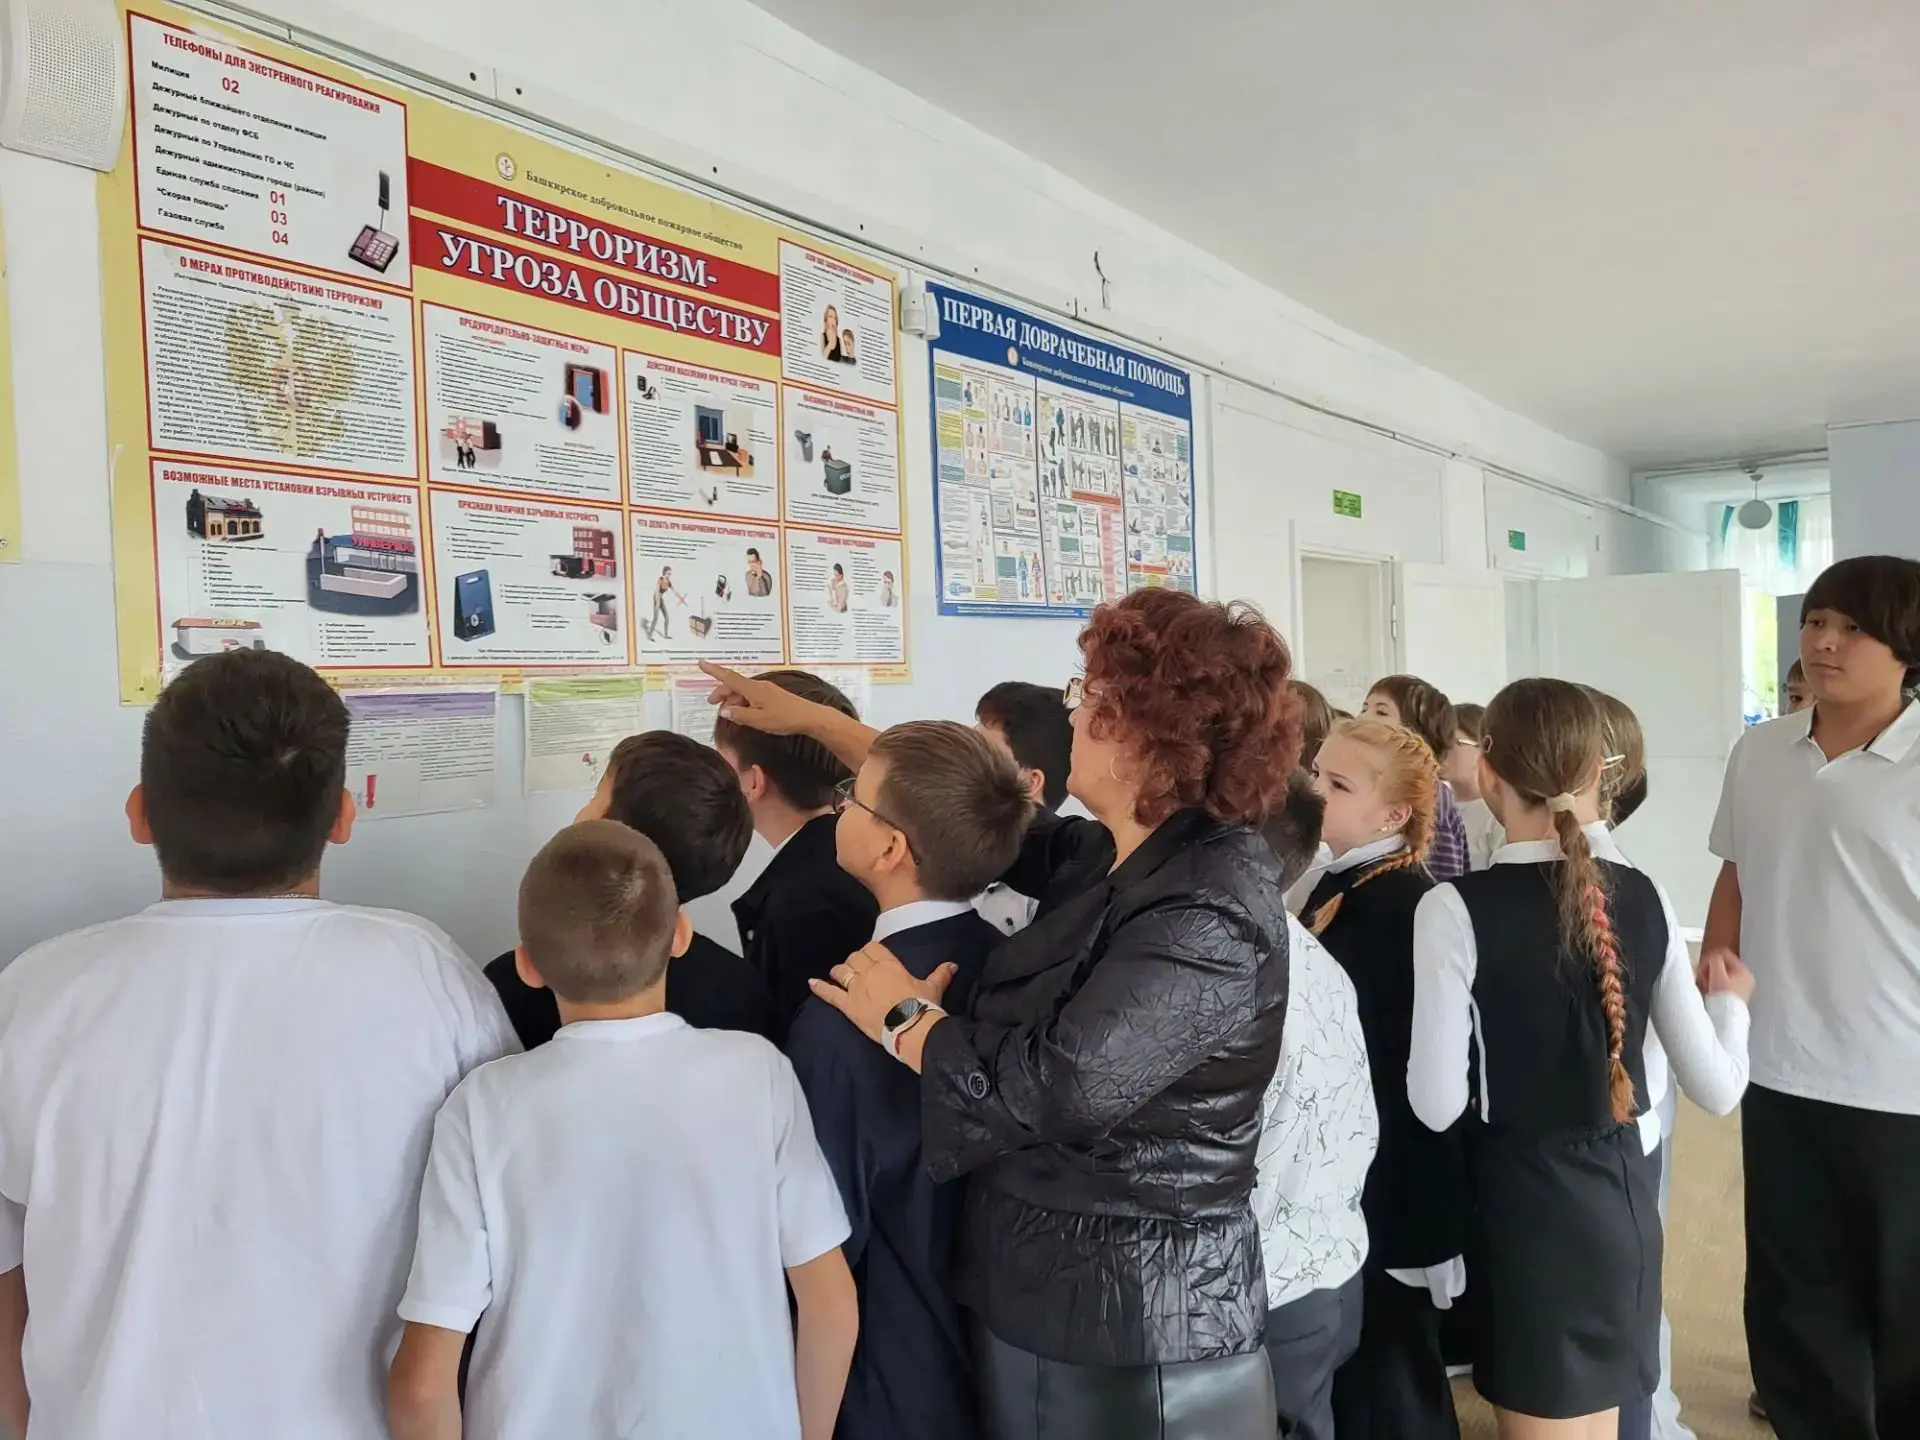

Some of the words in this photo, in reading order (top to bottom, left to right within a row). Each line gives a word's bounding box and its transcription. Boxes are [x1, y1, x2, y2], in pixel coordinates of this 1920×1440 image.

[151, 60, 190, 79] Милиция
[163, 33, 223, 62] ТЕЛЕФОНЫ
[224, 53, 246, 69] ДЛЯ
[248, 60, 313, 92] ЭКСТРЕННОГО
[315, 81, 381, 113] РЕАГИРОВАНИЯ
[222, 77, 240, 95] 02
[152, 82, 198, 102] Дежурный
[200, 95, 251, 118] ближайшего
[252, 113, 293, 131] отделения
[153, 103, 198, 123] Дежурный
[200, 117, 211, 126] по
[212, 120, 240, 136] отделу
[242, 128, 259, 140] ФСБ
[154, 124, 199, 144] Дежурный
[201, 137, 211, 146] по
[213, 140, 263, 161] Управлению
[264, 154, 275, 164] ГО
[283, 159, 295, 170] ЧС
[155, 145, 200, 165] Дежурный
[202, 158, 264, 181] администрации
[266, 175, 292, 189] города
[294, 182, 326, 199] (района)
[156, 166, 187, 181] Единая
[189, 174, 220, 190] служба
[222, 184, 260, 200] спасения
[270, 191, 286, 206] 01
[271, 211, 287, 226] 03
[526, 170, 588, 202] Башкирское
[589, 196, 656, 225] добровольное
[657, 215, 702, 239] пожарное
[703, 231, 743, 250] общество
[158, 208, 192, 224] Газовая
[194, 215, 225, 232] служба
[272, 231, 289, 246] 04
[497, 194, 718, 288] ТЕРРОРИЗМ-
[180, 255, 188, 268] О
[190, 258, 223, 276] МЕРАХ
[225, 266, 324, 297] ПРОТИВОДЕЙСТВИЮ
[326, 289, 383, 310] ТЕРРОРИЗМУ
[437, 231, 589, 304] УГРОЗА
[593, 277, 771, 347] ОБЩЕСТВУ
[943, 296, 1017, 342] ПЕРВАЯ
[1019, 322, 1126, 377] ДОВРАЧЕБНАЯ
[1128, 360, 1186, 398] ПОМОЩЬ
[163, 470, 229, 487] ВОЗМОЖНЫЕ
[231, 477, 261, 490] МЕСТА
[263, 481, 315, 496] УСТАНОВКИ
[316, 486, 365, 500] ВЗРЫВНЫХ
[367, 491, 412, 504] УСТРОЙСТВ
